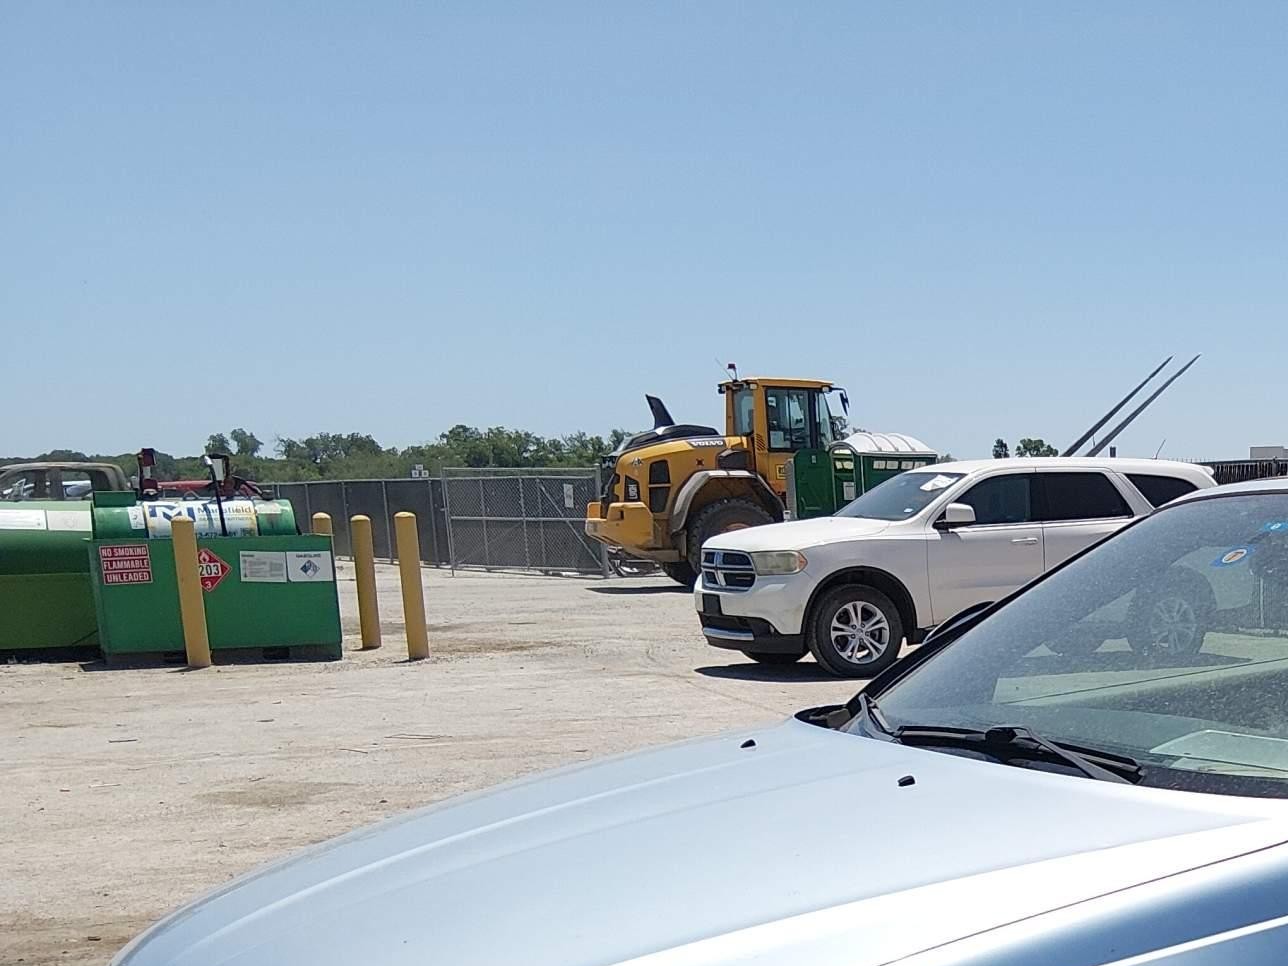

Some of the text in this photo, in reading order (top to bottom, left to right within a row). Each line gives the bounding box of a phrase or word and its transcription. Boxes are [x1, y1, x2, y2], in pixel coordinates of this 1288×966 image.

[197, 506, 252, 515] Mnsfield
[101, 547, 147, 557] NO SMOKING
[103, 560, 150, 570] FLAMMABLE
[199, 564, 220, 576] 203
[106, 572, 149, 582] UNLEADED
[204, 580, 212, 589] 3
